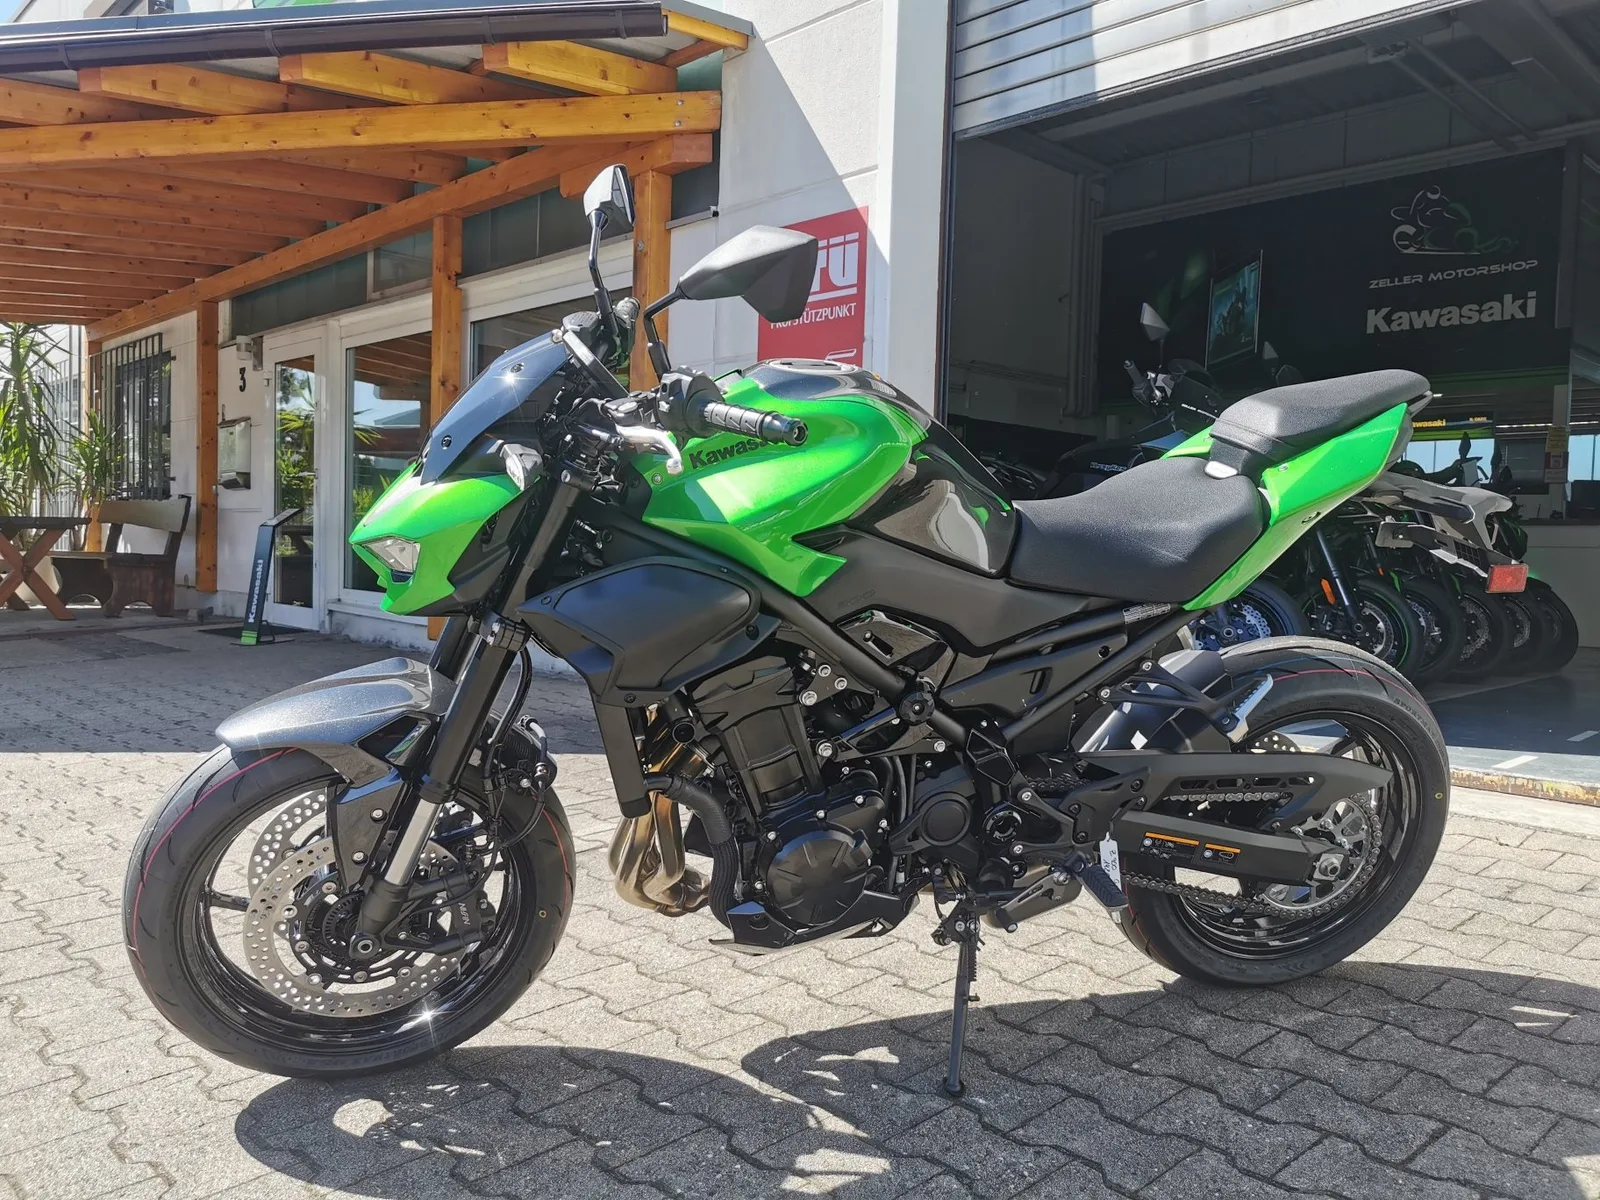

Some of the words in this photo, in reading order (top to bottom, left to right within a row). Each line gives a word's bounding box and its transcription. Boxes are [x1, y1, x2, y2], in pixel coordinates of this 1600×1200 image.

[1369, 274, 1423, 289] ZELLER
[1428, 260, 1538, 282] MOTORSHOP
[1366, 291, 1537, 334] Kawasaki
[239, 366, 246, 392] 3
[689, 438, 770, 469] Kawas
[248, 559, 264, 623] Kawasaki
